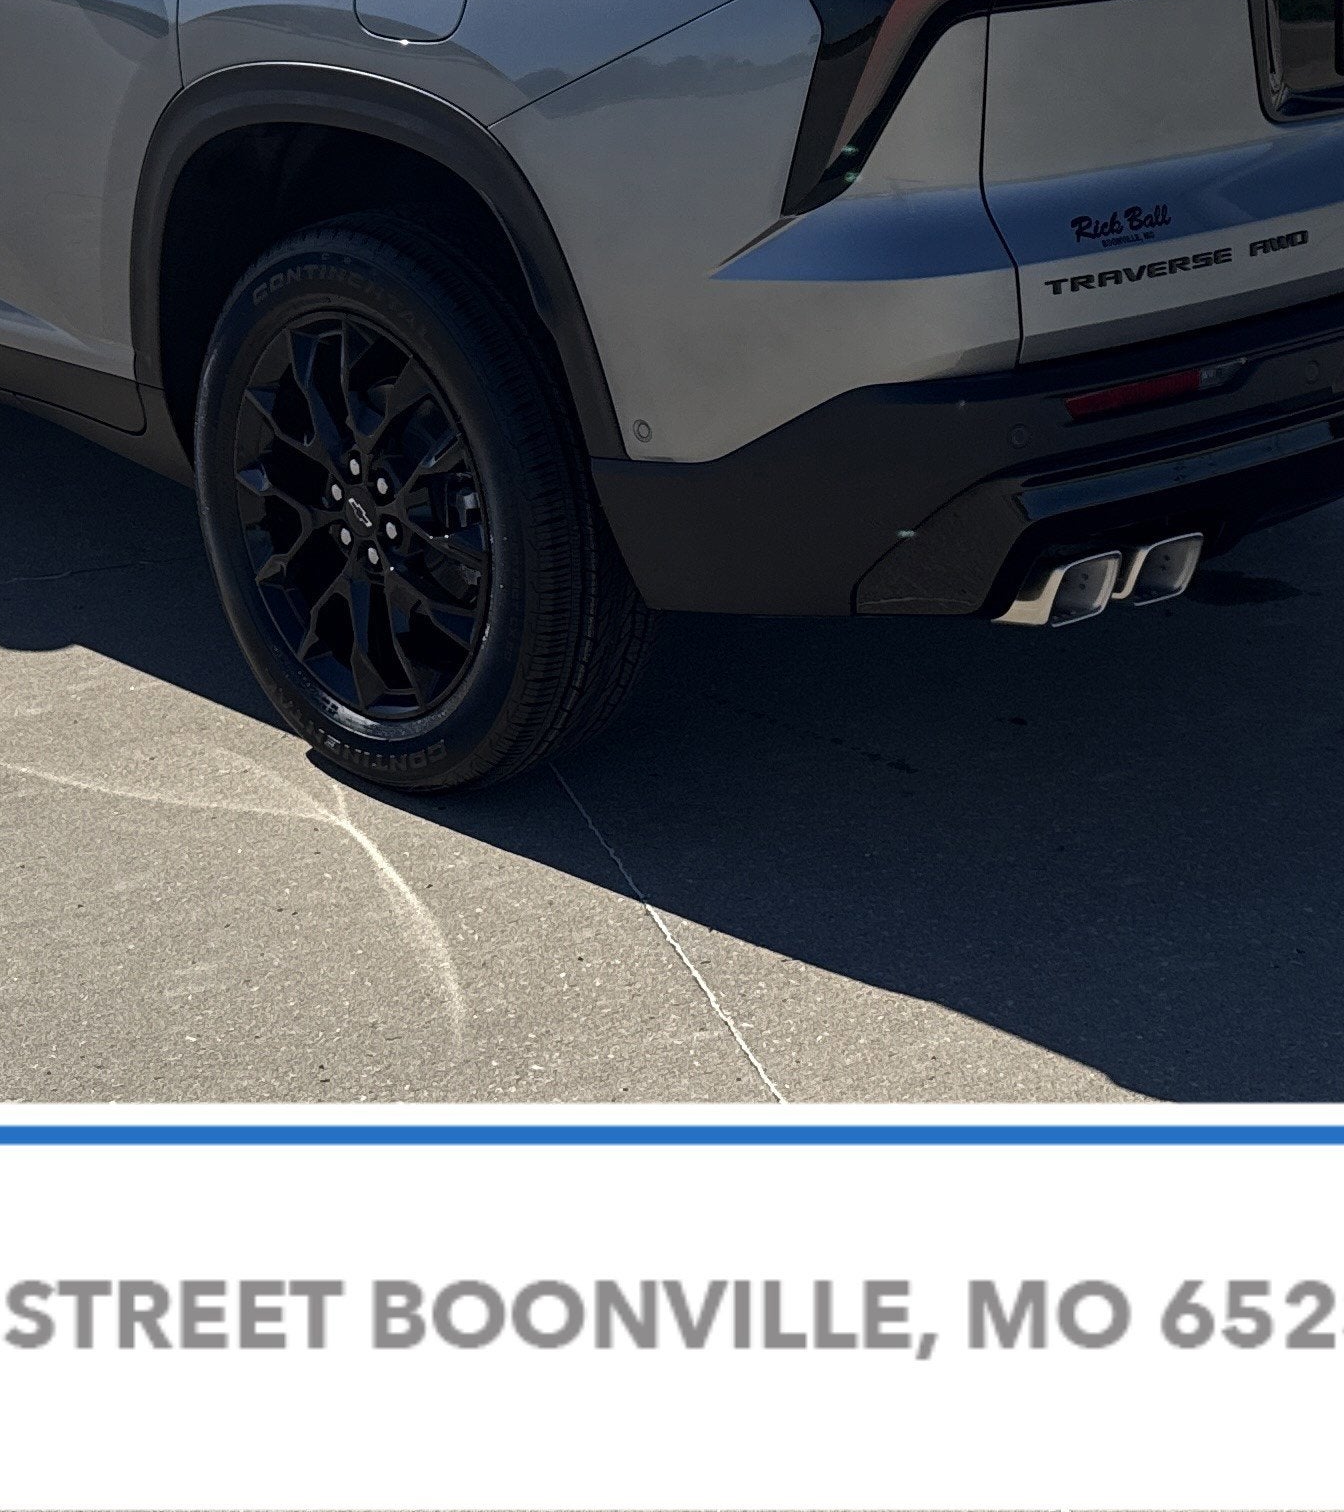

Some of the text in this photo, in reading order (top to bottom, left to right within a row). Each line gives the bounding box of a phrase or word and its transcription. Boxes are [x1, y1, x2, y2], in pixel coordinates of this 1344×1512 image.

[1070, 203, 1172, 243] Rick Ball
[1045, 230, 1309, 295] TRAVERSE AWD
